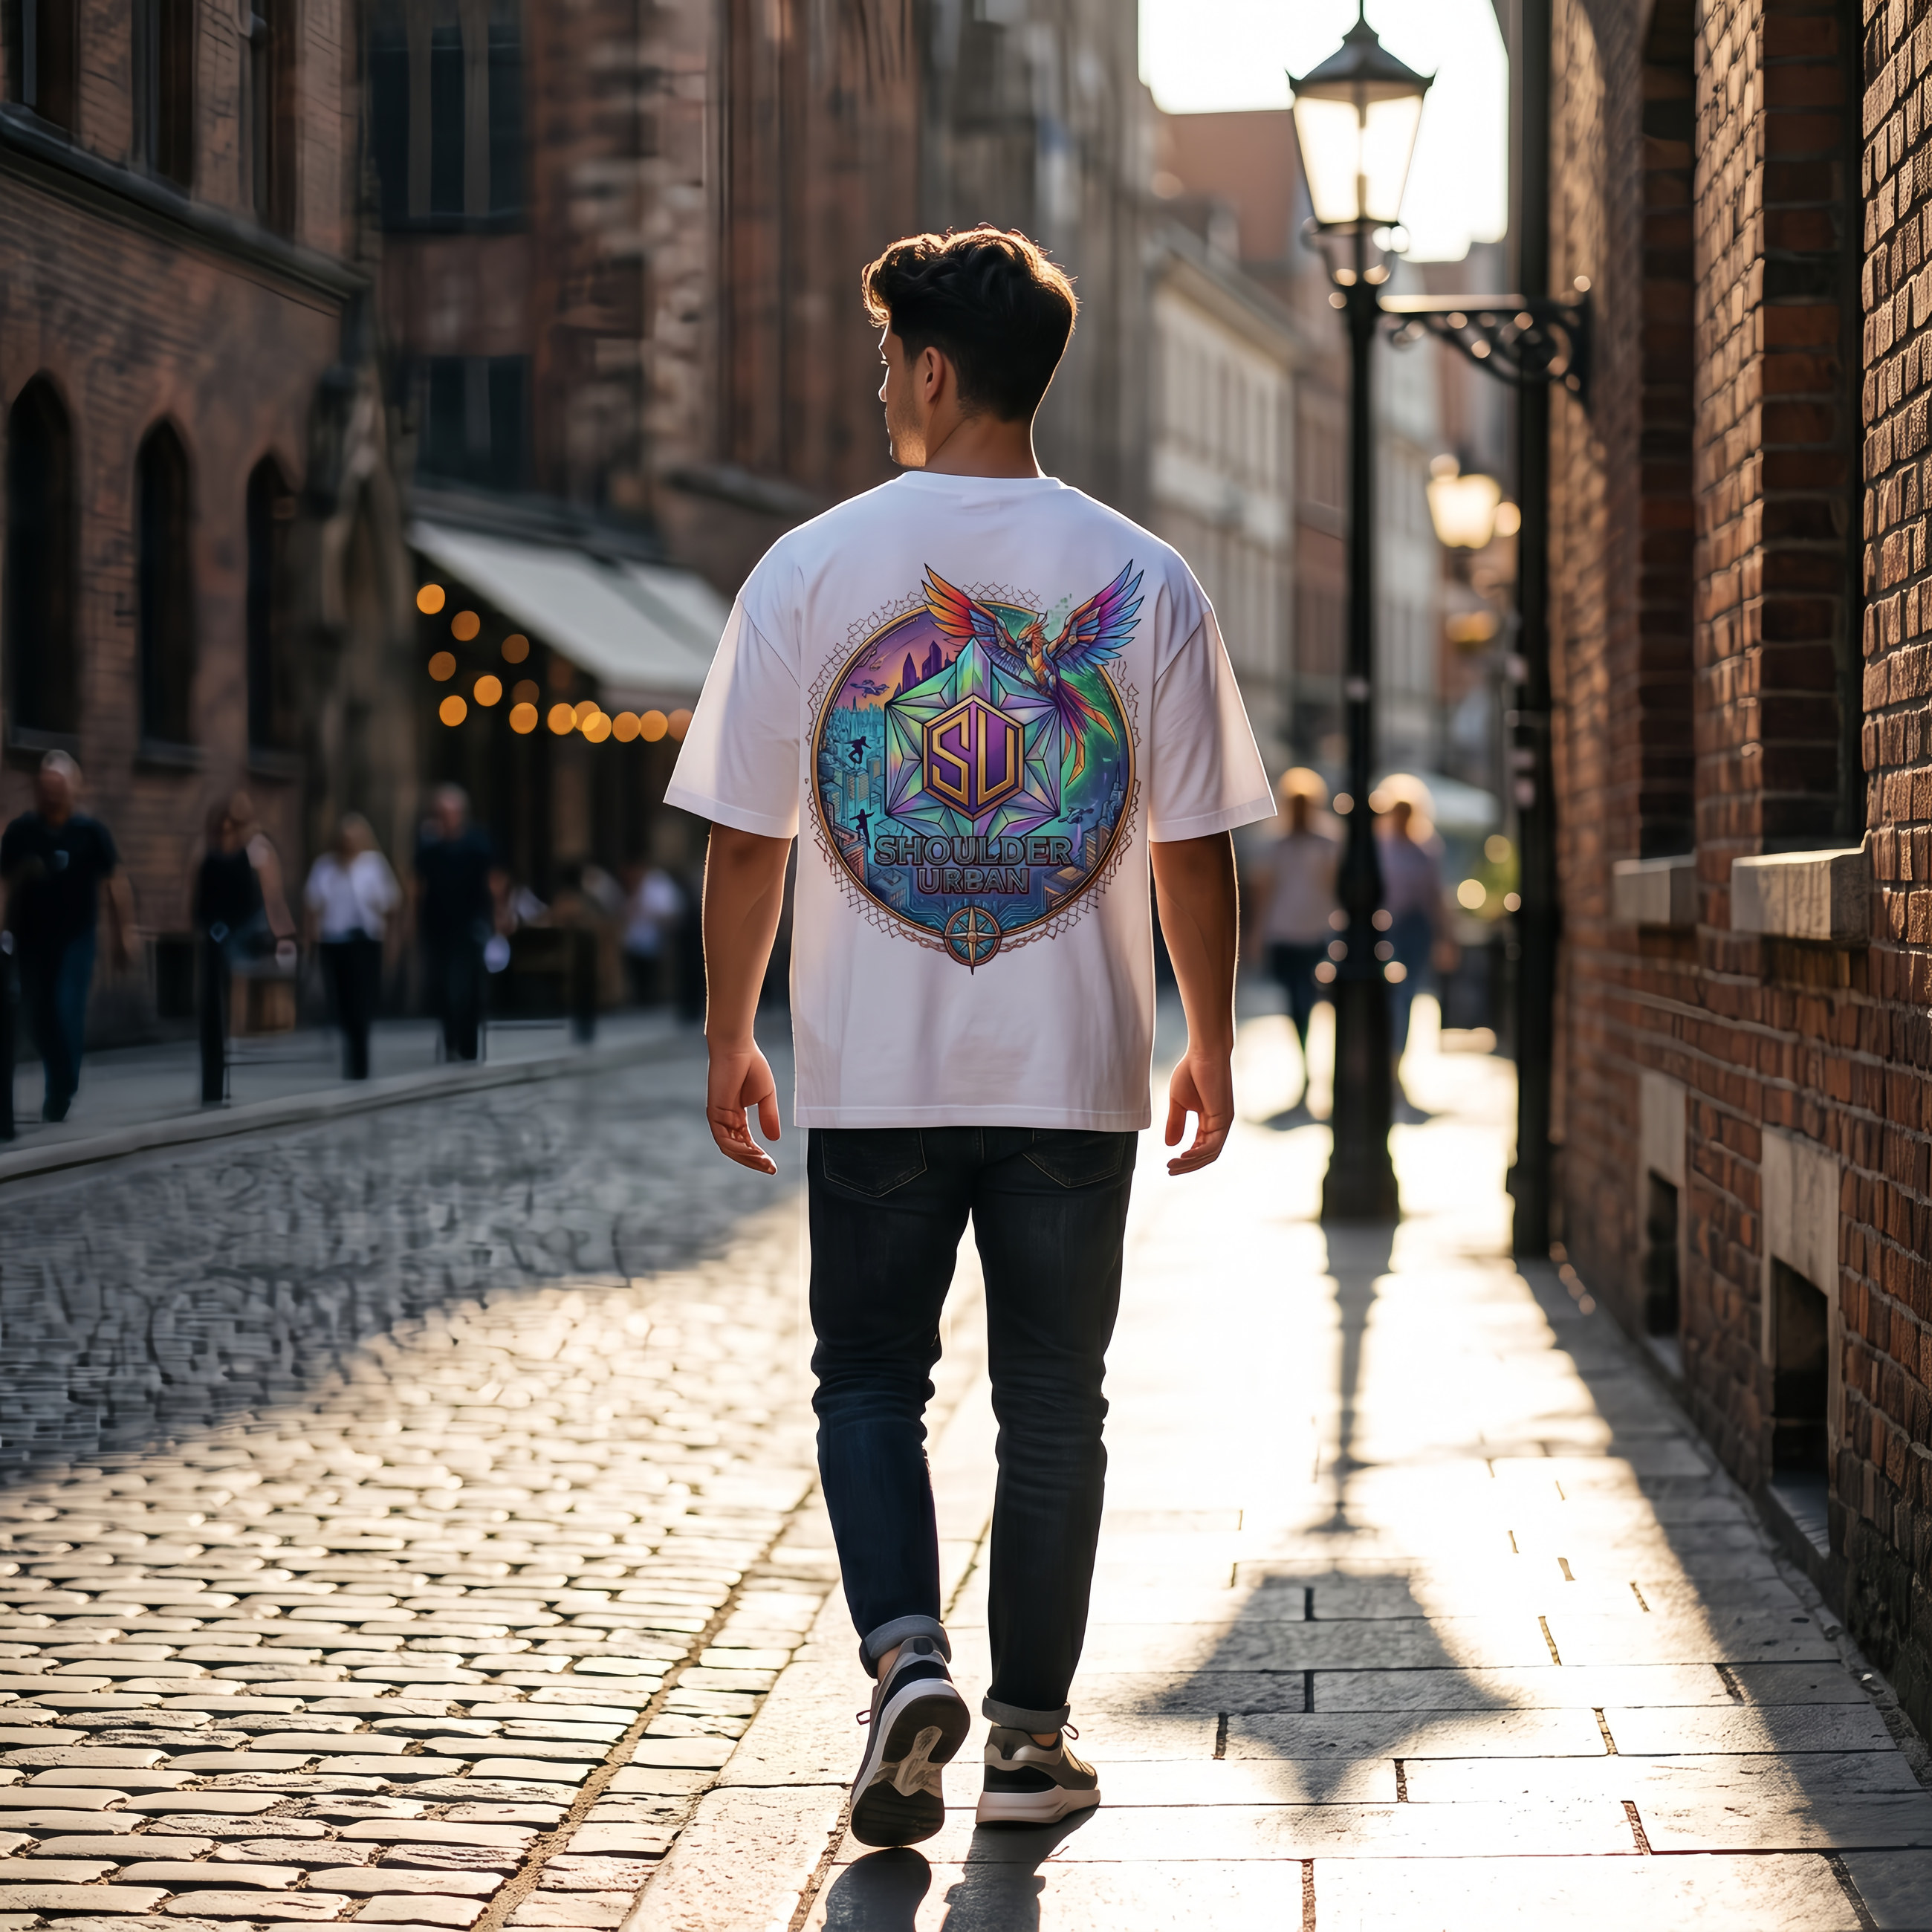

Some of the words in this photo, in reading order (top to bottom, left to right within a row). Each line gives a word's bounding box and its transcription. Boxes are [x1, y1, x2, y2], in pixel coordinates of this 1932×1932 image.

[932, 707, 1015, 807] SU
[874, 836, 1072, 866] SHOULDER
[917, 868, 1030, 894] URBAN
